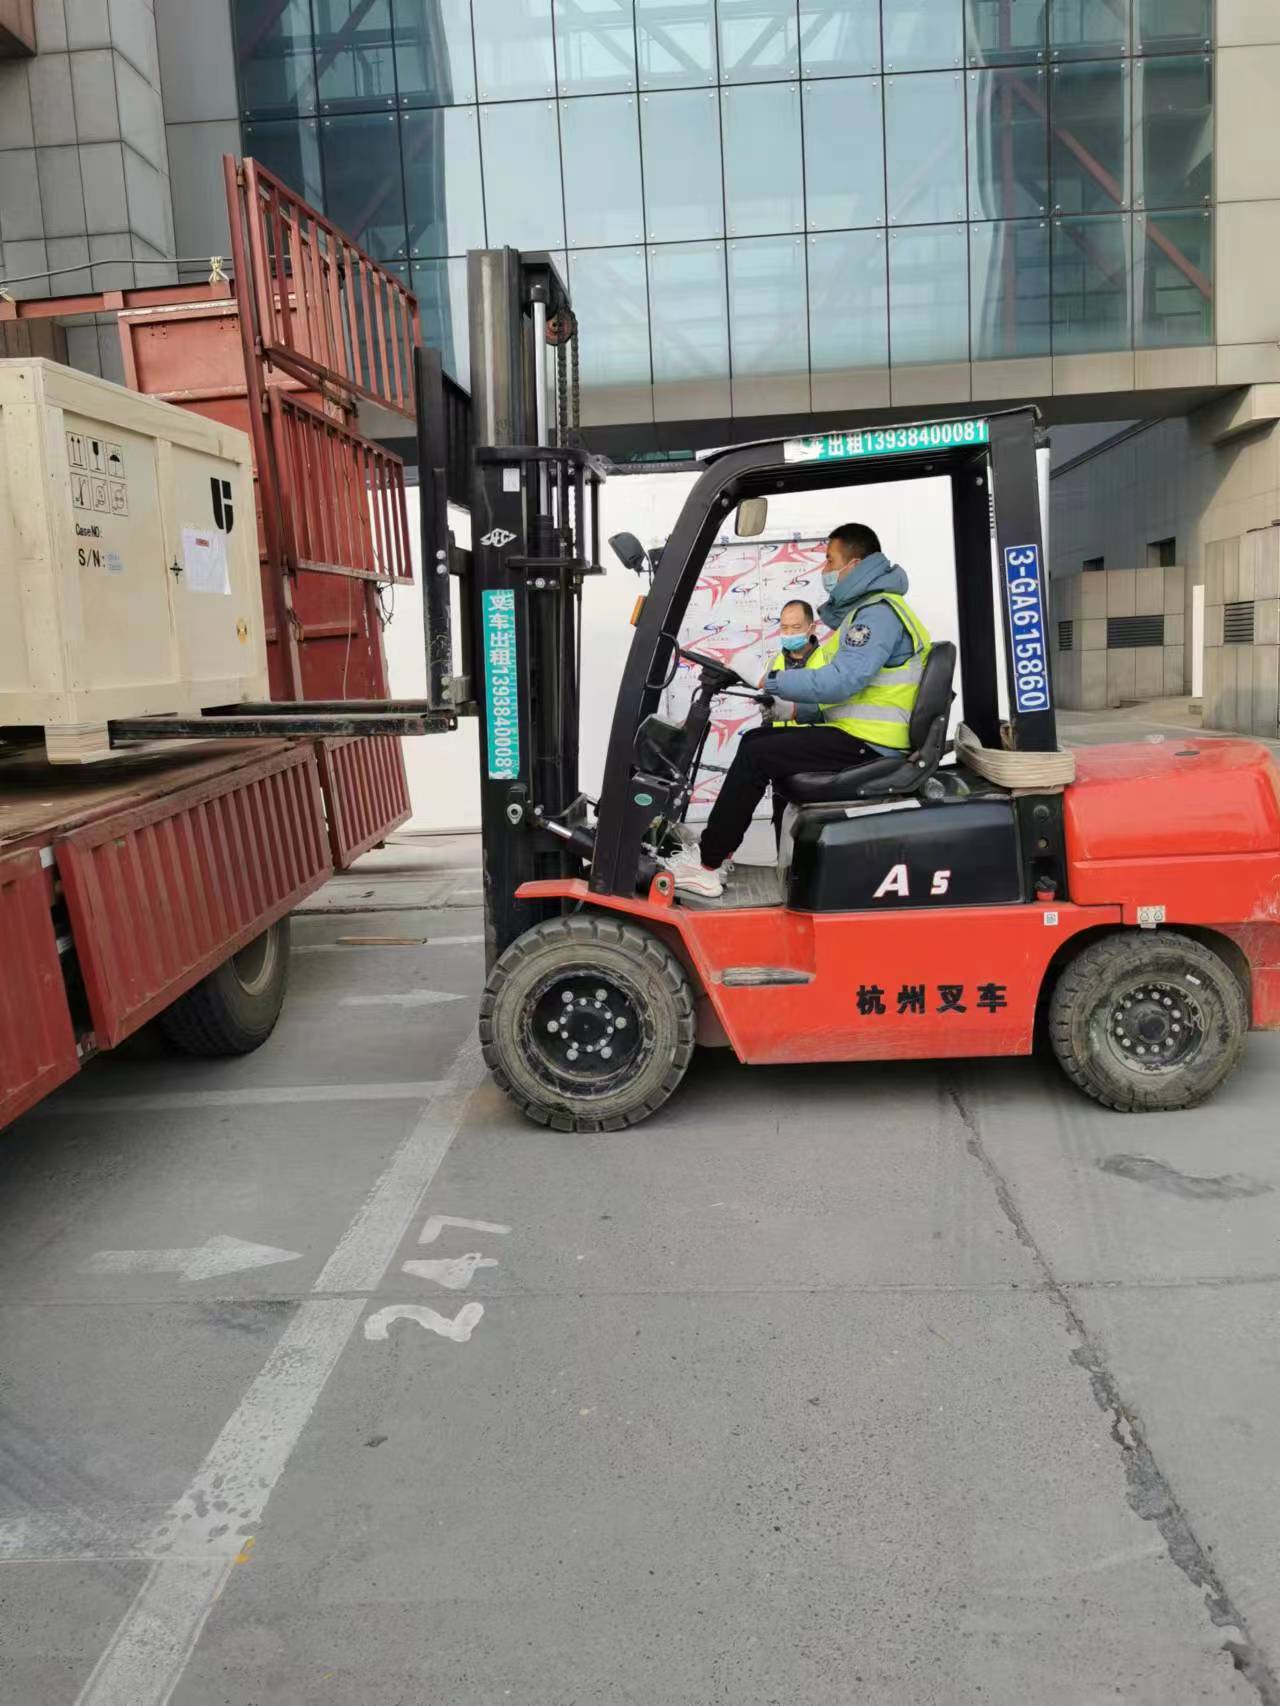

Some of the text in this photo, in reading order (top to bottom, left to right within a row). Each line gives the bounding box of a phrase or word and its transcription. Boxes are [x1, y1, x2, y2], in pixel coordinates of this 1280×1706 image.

[1008, 551, 1045, 706] 3-GA615860
[856, 982, 1008, 1016] 杭州叉车
